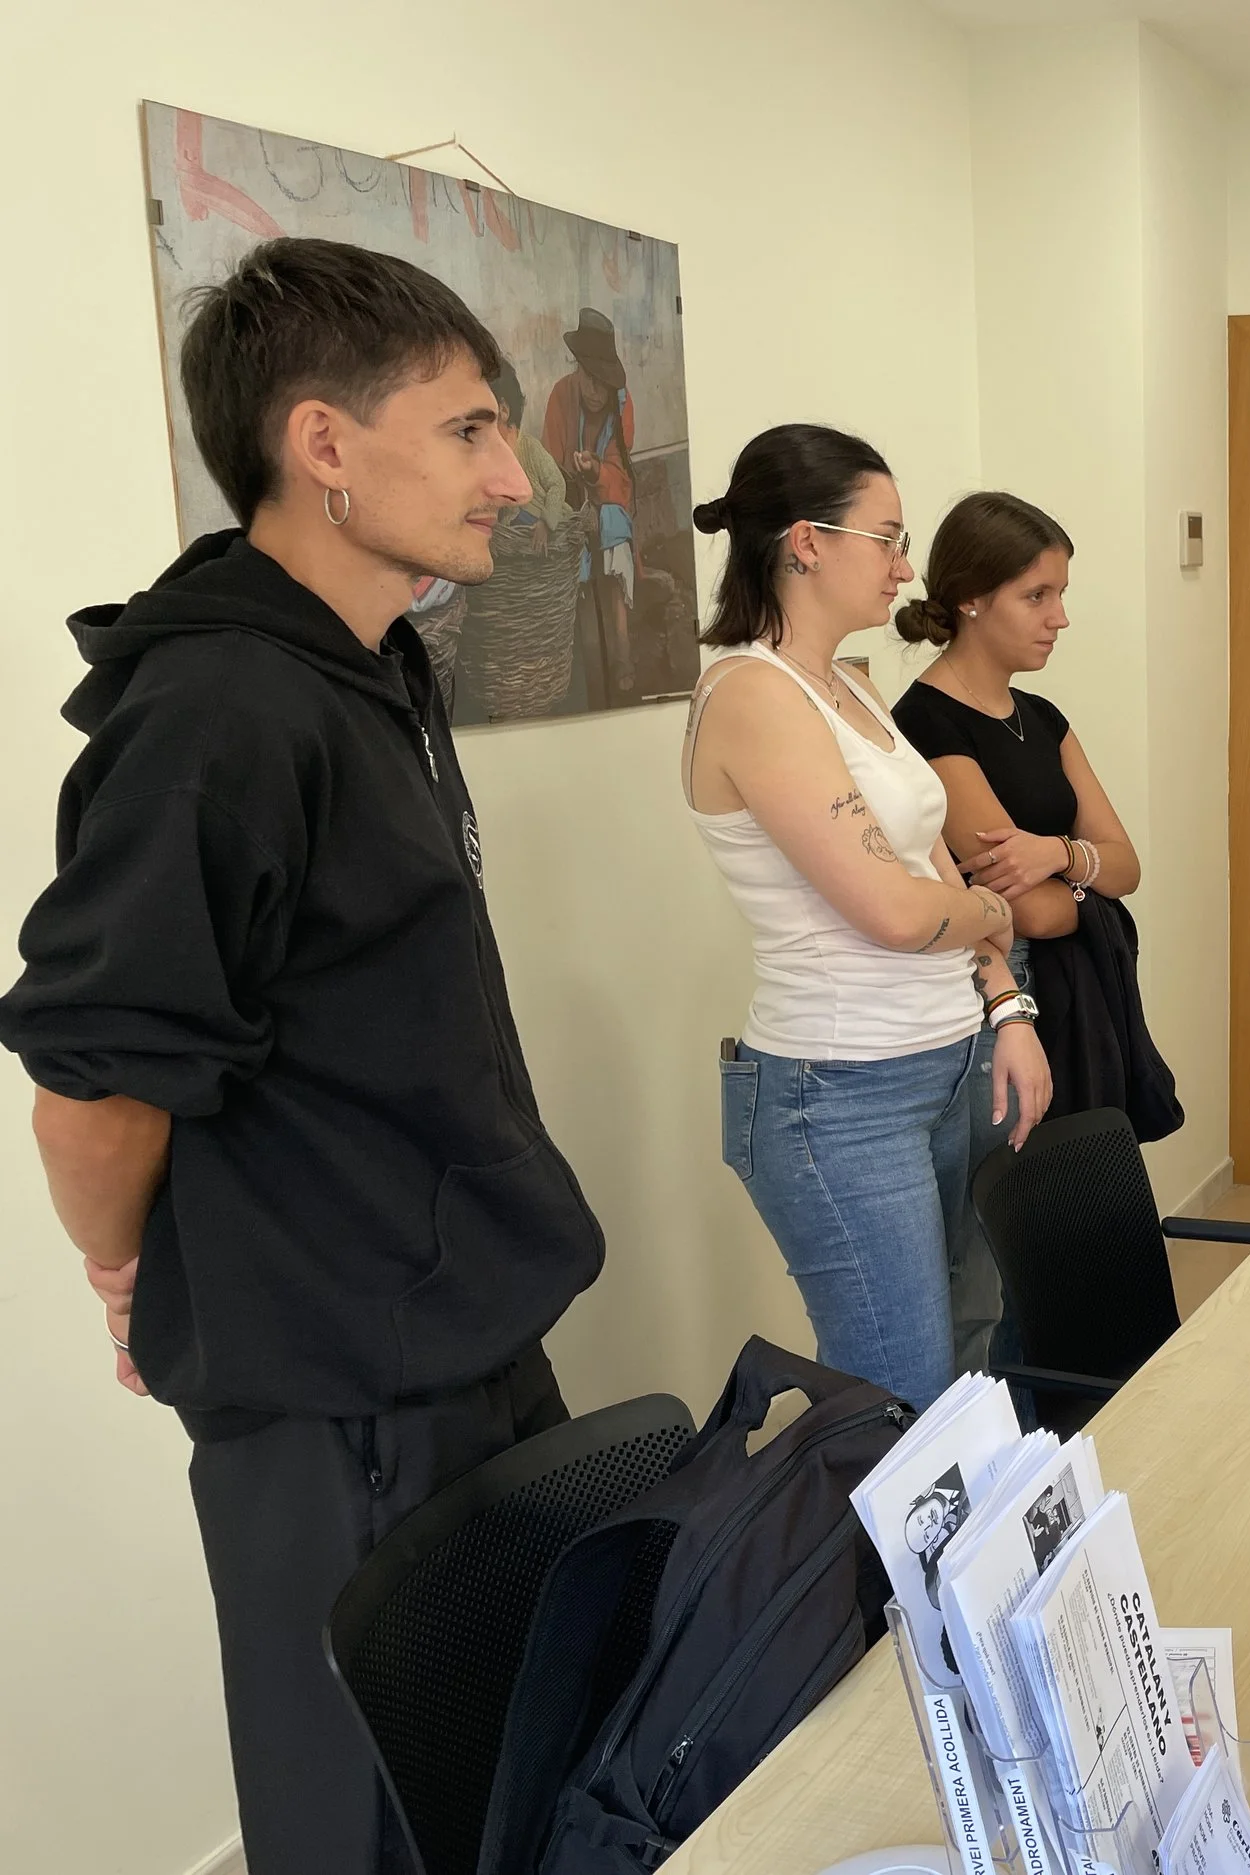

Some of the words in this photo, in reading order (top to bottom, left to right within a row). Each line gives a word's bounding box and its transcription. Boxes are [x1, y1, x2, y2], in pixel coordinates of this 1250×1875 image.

[1108, 1593, 1121, 1633] ¿Dónde
[1119, 1635, 1132, 1668] puedo
[1130, 1670, 1148, 1730] aprenderlos
[1147, 1732, 1152, 1743] en
[1150, 1745, 1164, 1783] Lleida?
[1120, 1594, 1166, 1756] CASTELLANO
[934, 1699, 962, 1772] ACOLLIDA
[1164, 1710, 1172, 1726] Y
[953, 1777, 977, 1842] PRIMERA
